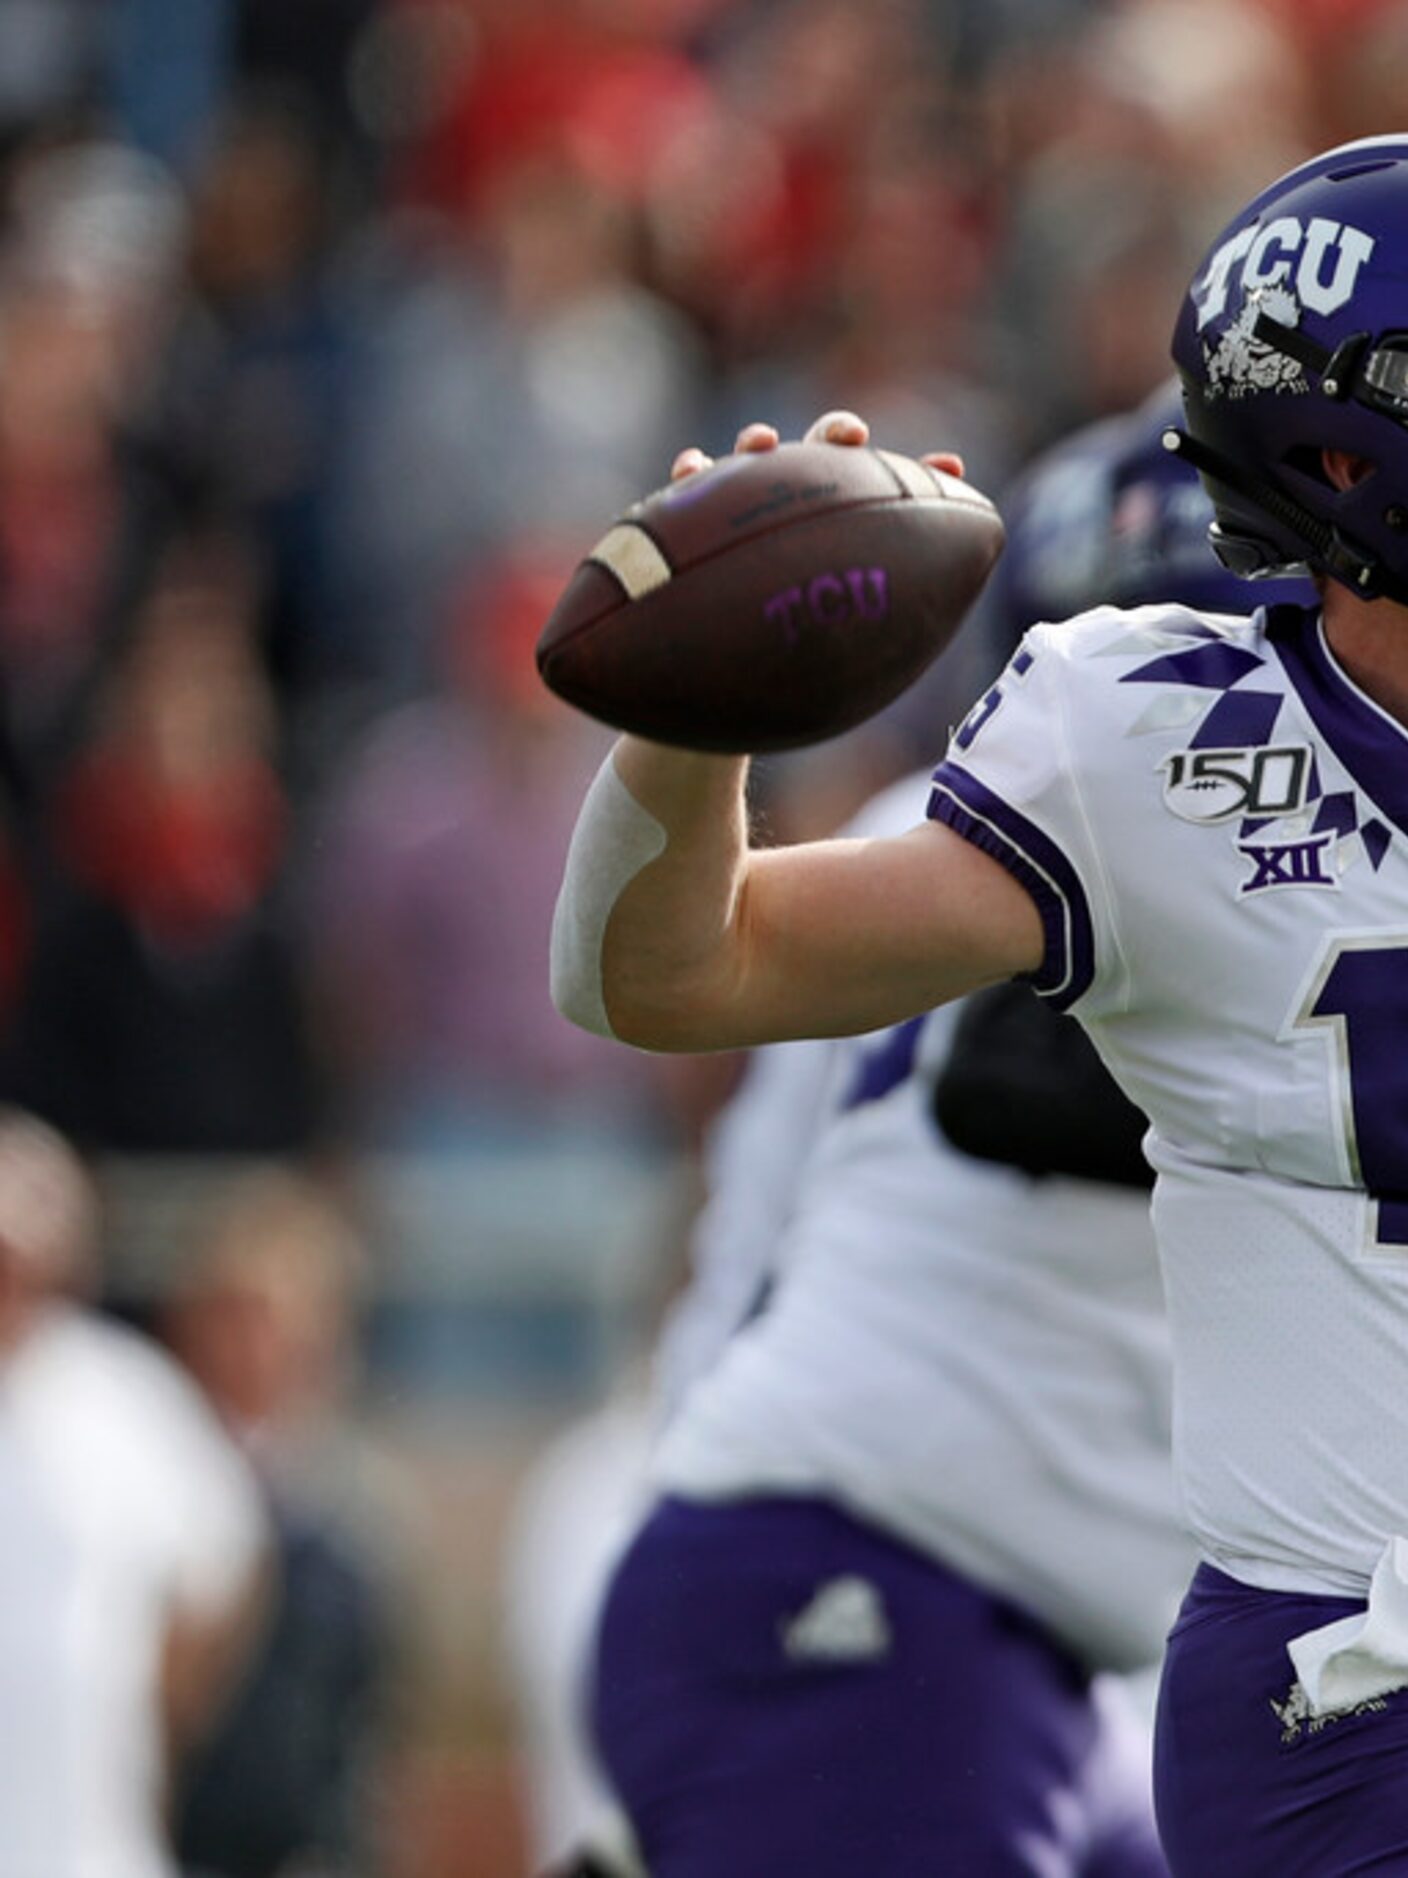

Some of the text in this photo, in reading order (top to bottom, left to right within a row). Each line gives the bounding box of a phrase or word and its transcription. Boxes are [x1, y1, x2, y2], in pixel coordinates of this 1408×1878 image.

[1191, 217, 1375, 333] TCU
[763, 568, 888, 645] TCU
[1168, 747, 1307, 821] 150
[1238, 838, 1335, 892] XII
